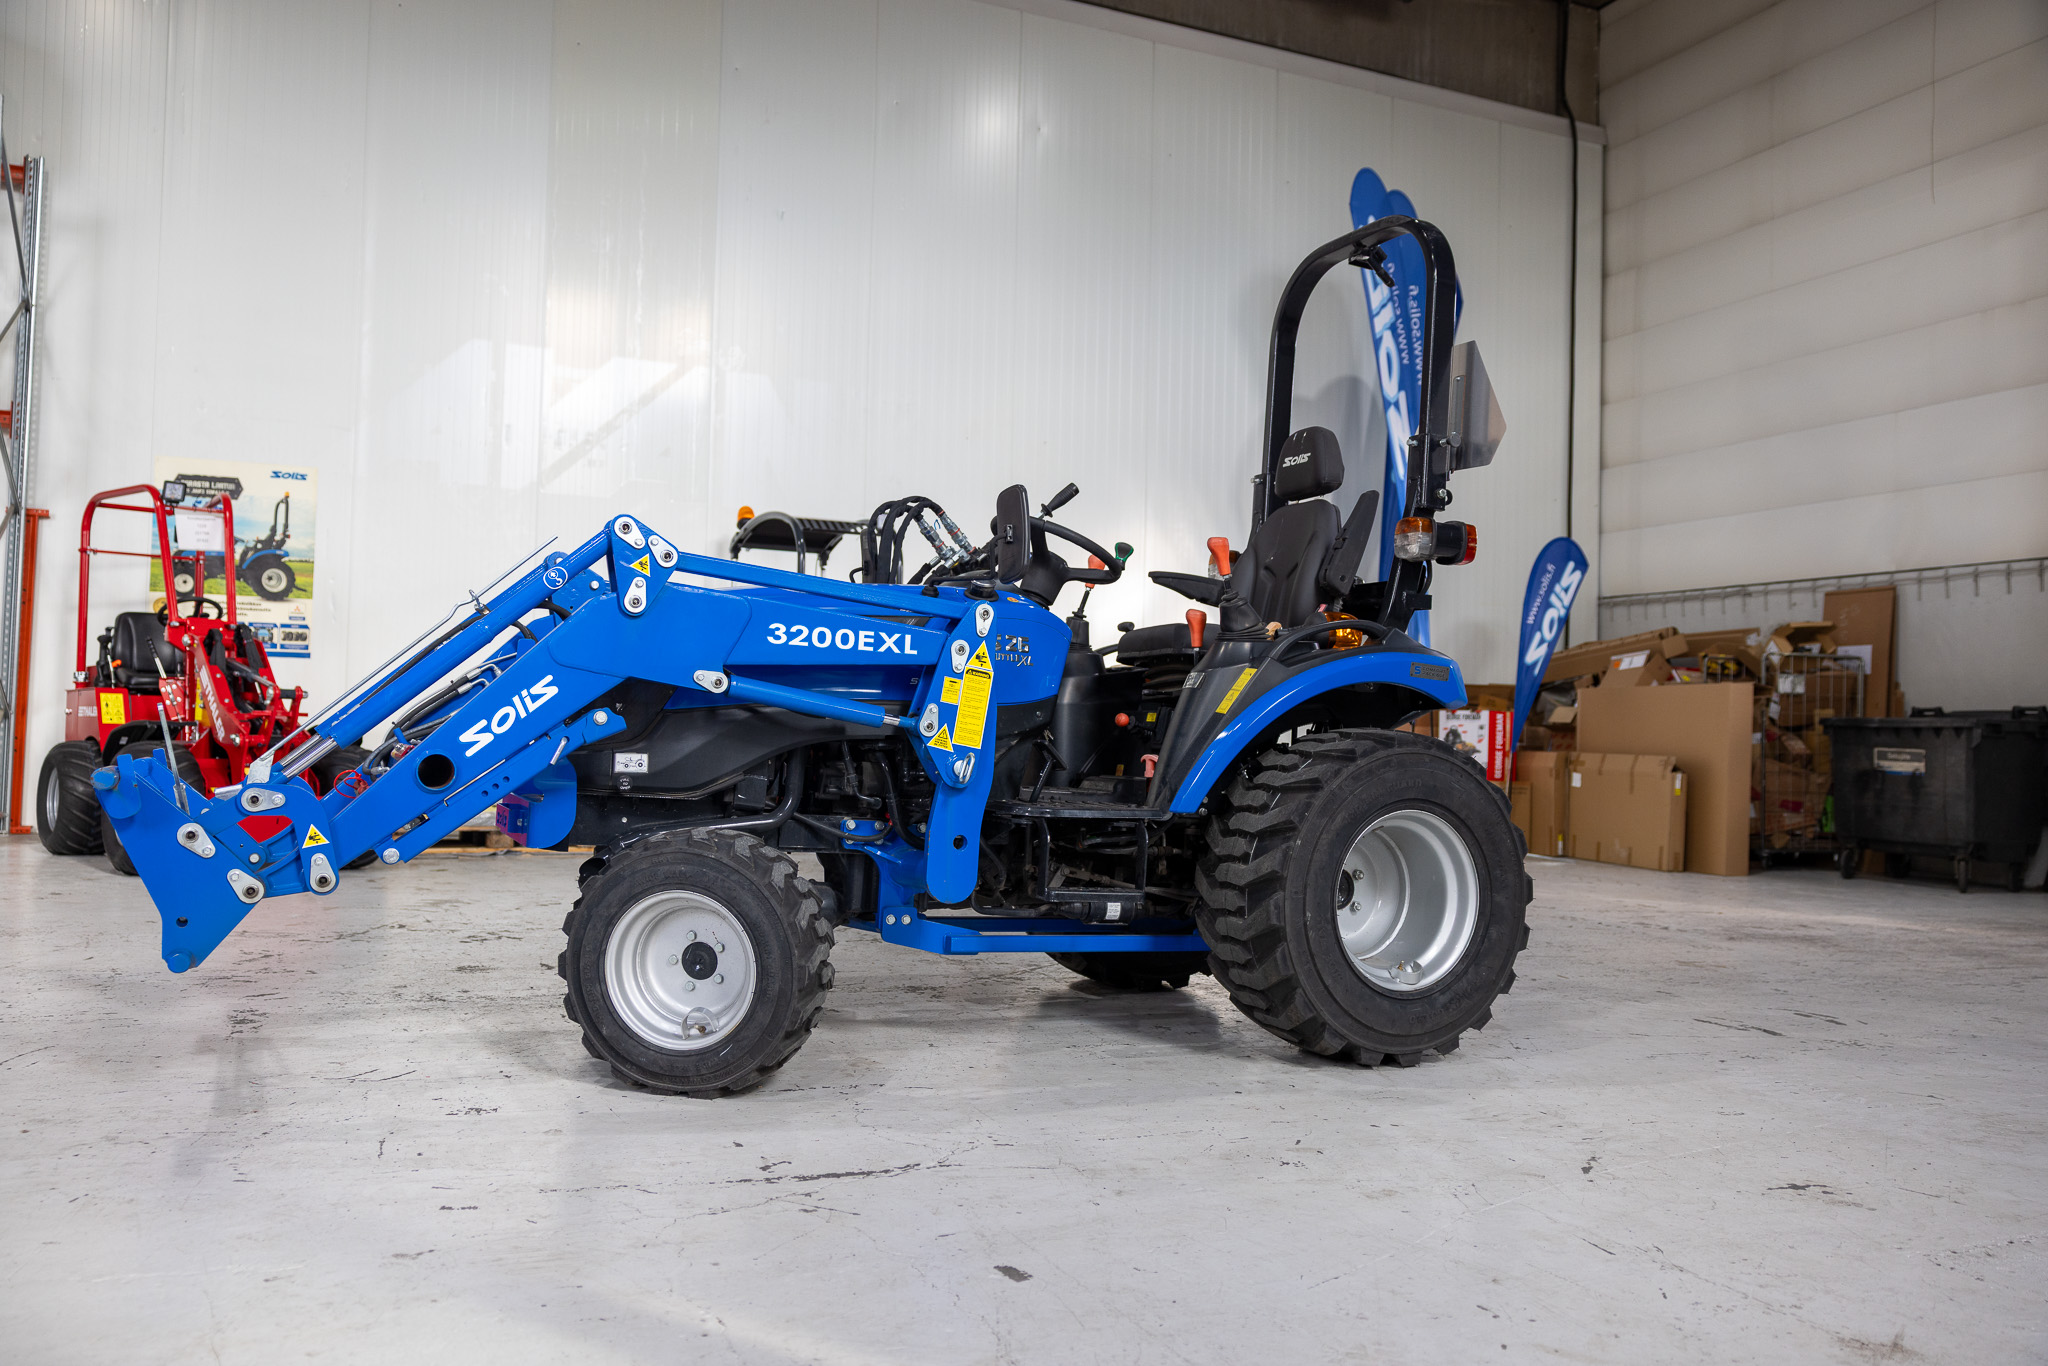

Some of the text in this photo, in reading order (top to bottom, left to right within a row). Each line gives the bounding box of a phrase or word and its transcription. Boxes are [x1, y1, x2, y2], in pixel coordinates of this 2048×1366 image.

[1526, 563, 1556, 625] www.solis.fi
[766, 622, 918, 655] 3200EXL
[458, 674, 559, 758] Solis
[1495, 713, 1504, 749] FOREMAN
